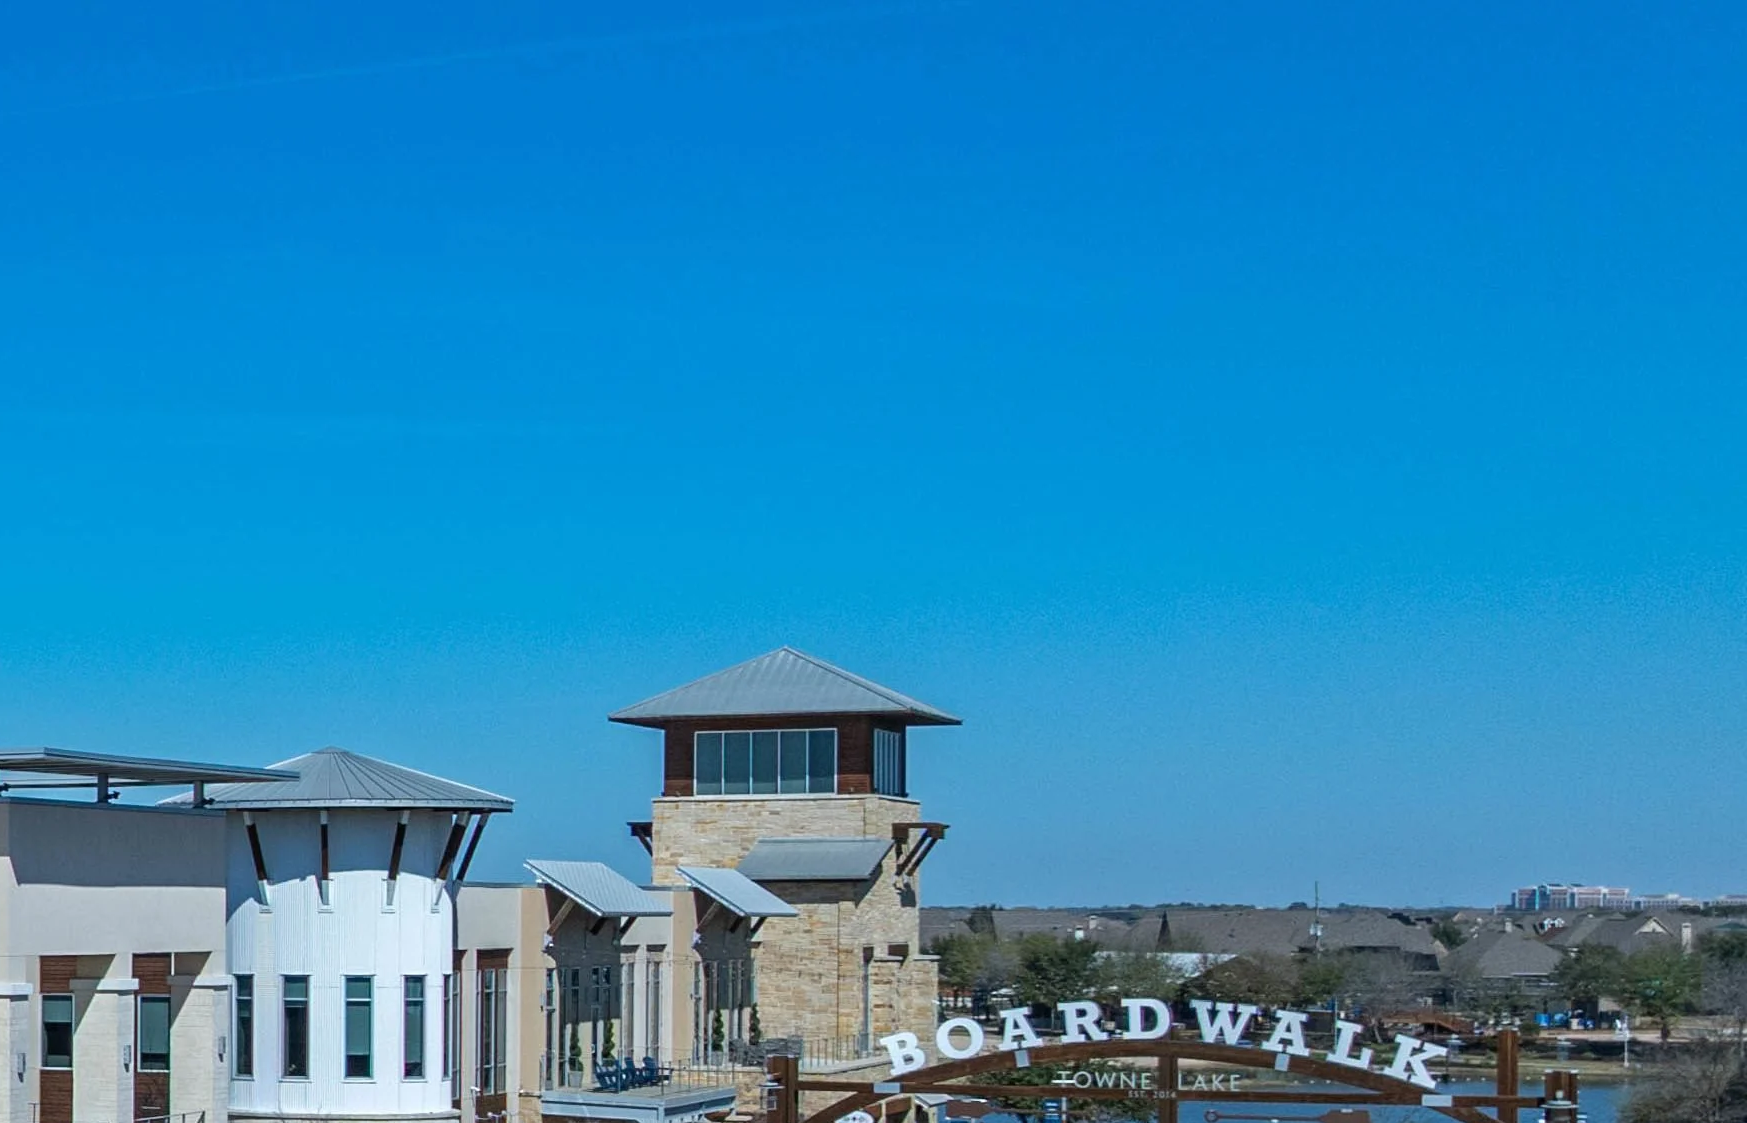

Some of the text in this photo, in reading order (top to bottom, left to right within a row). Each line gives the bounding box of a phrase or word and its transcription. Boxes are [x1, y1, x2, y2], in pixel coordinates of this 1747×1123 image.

[880, 998, 1449, 1090] BOARDWALK
[1057, 1070, 1241, 1091] TOWNE LAKE
